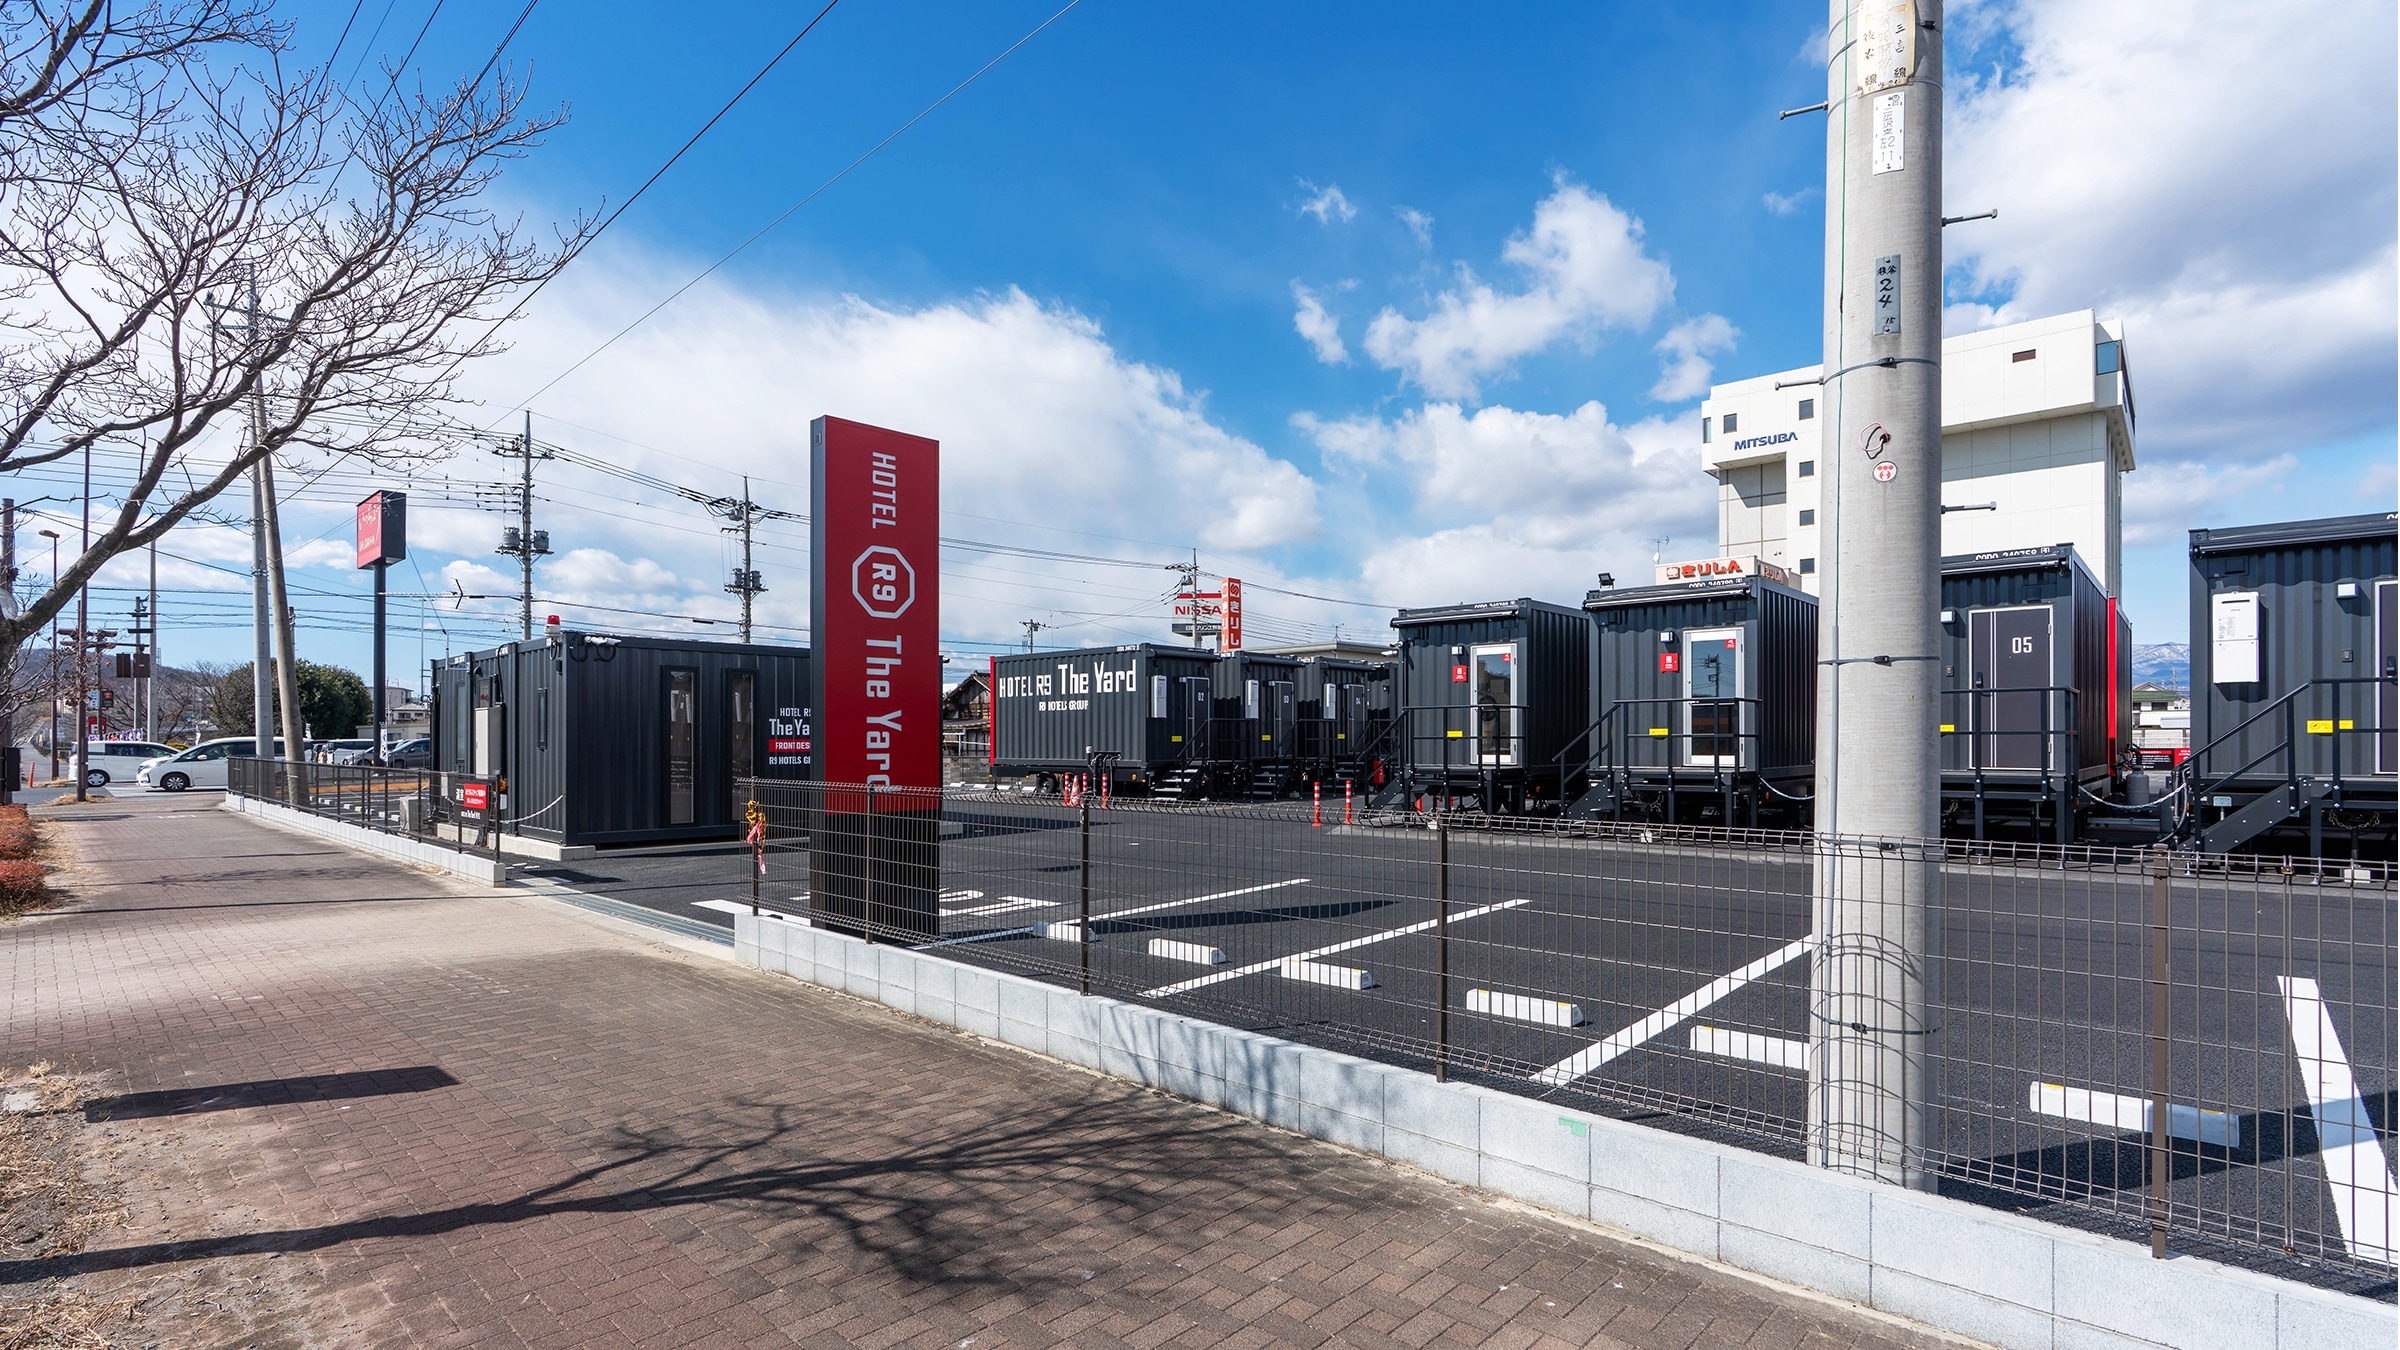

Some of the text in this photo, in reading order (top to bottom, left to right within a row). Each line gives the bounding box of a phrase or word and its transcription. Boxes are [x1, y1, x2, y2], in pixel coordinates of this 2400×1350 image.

[1734, 431, 1799, 450] MITSUBA
[872, 452, 897, 530] HOTEL
[1681, 559, 1743, 577] きりしん
[872, 562, 897, 602] R9
[1175, 605, 1222, 615] NISSA
[2012, 636, 2033, 654] 05
[866, 634, 902, 698] The
[1000, 659, 1137, 698] HOTEL R9 The Yard
[780, 707, 801, 717] HOTEL
[1069, 700, 1088, 710] GROUP
[769, 718, 810, 736] The Ya
[776, 741, 810, 750] FRONT DES
[779, 756, 802, 765] HOTELS
